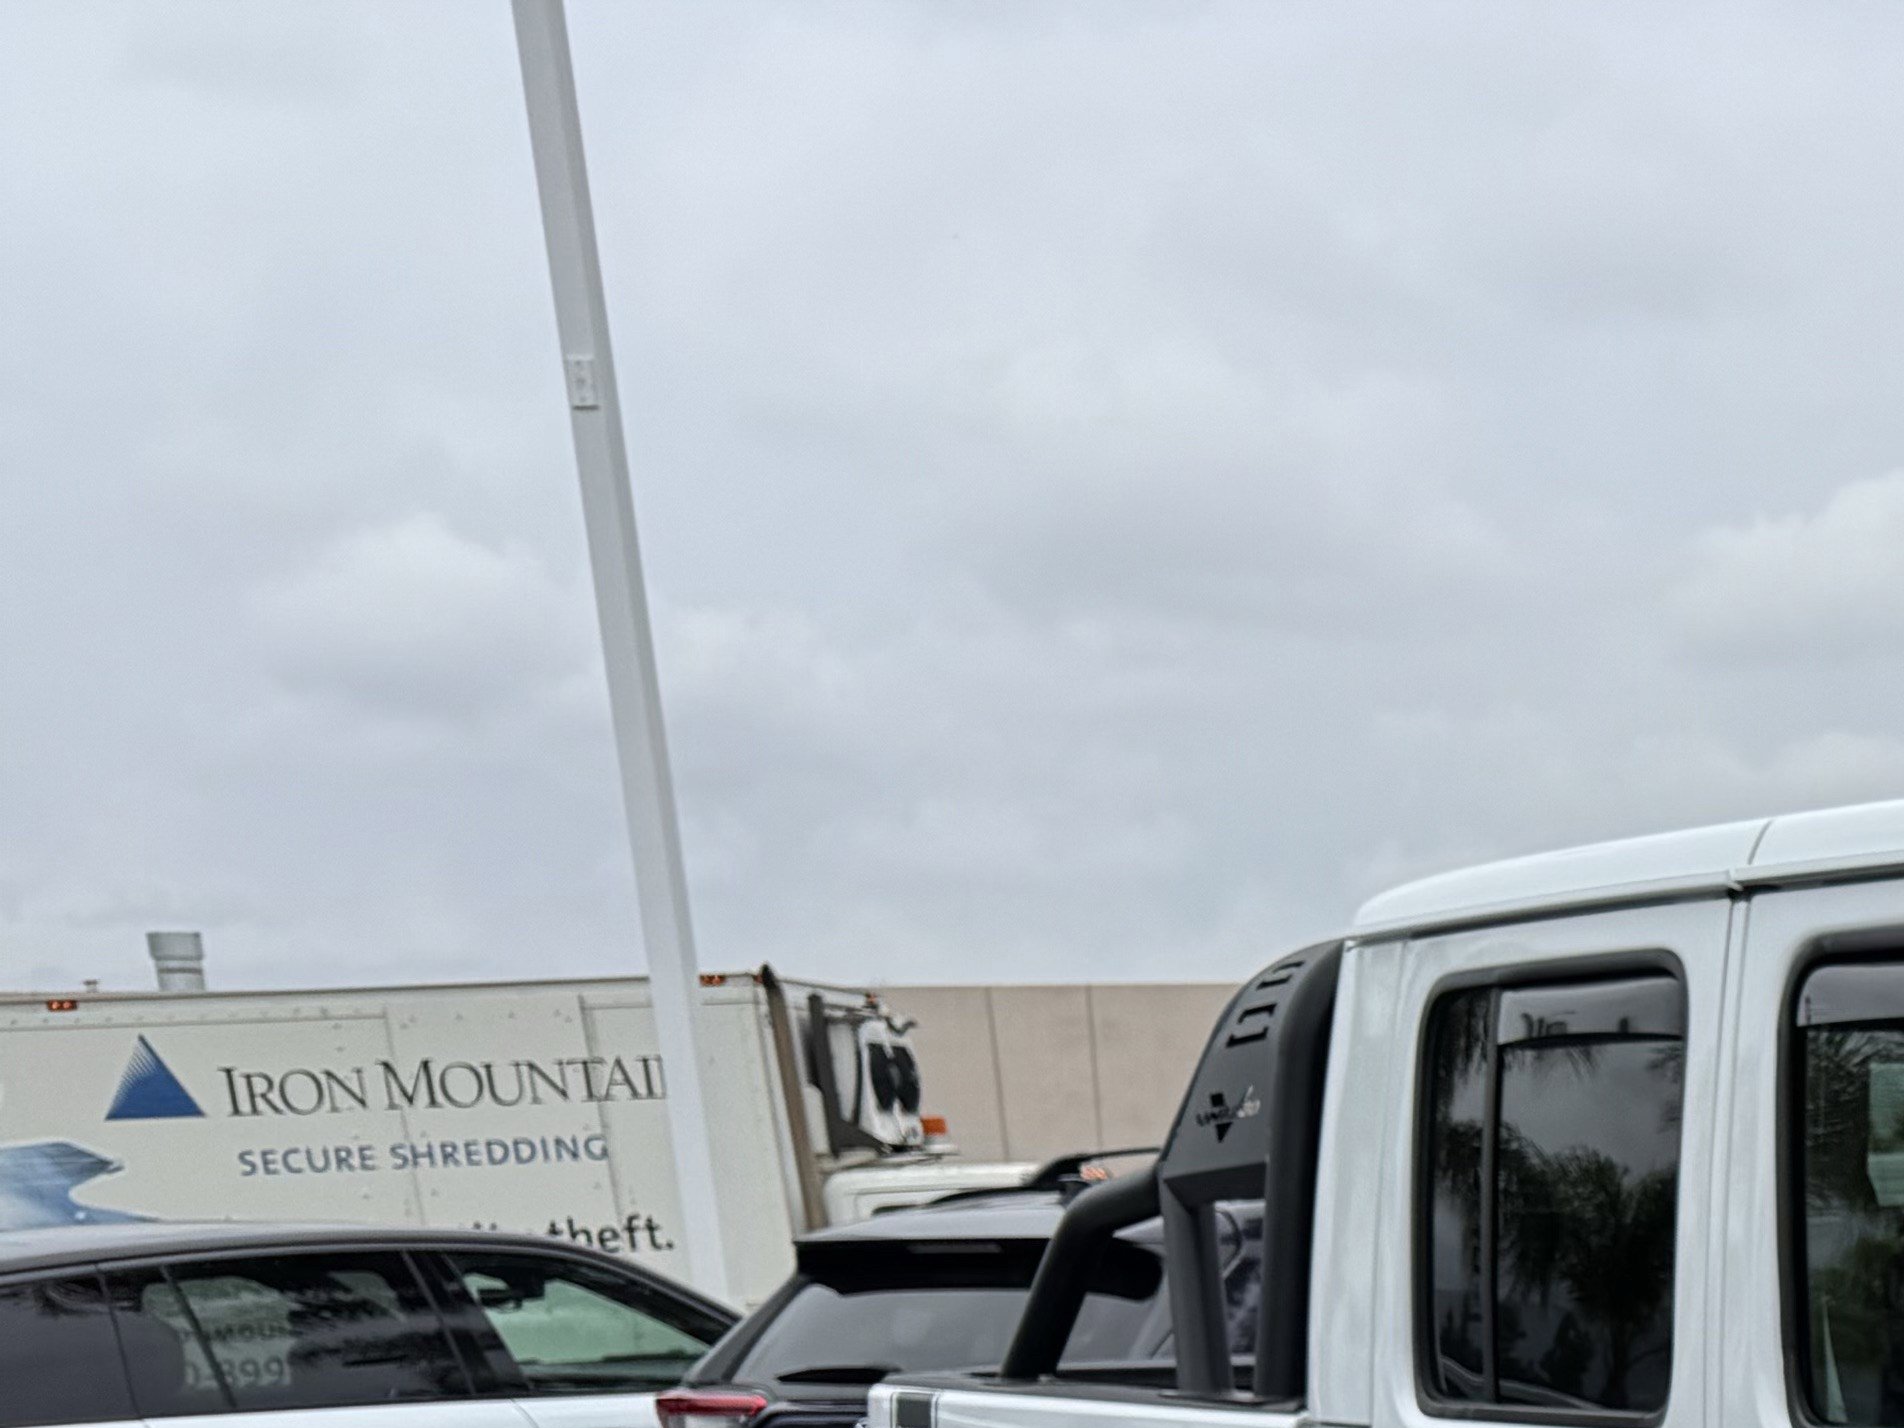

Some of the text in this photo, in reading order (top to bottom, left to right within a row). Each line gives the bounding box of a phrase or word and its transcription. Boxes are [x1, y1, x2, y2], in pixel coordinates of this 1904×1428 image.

[217, 1054, 667, 1117] IRON MOUNTAI
[238, 1134, 609, 1177] SECURE SHREDDING
